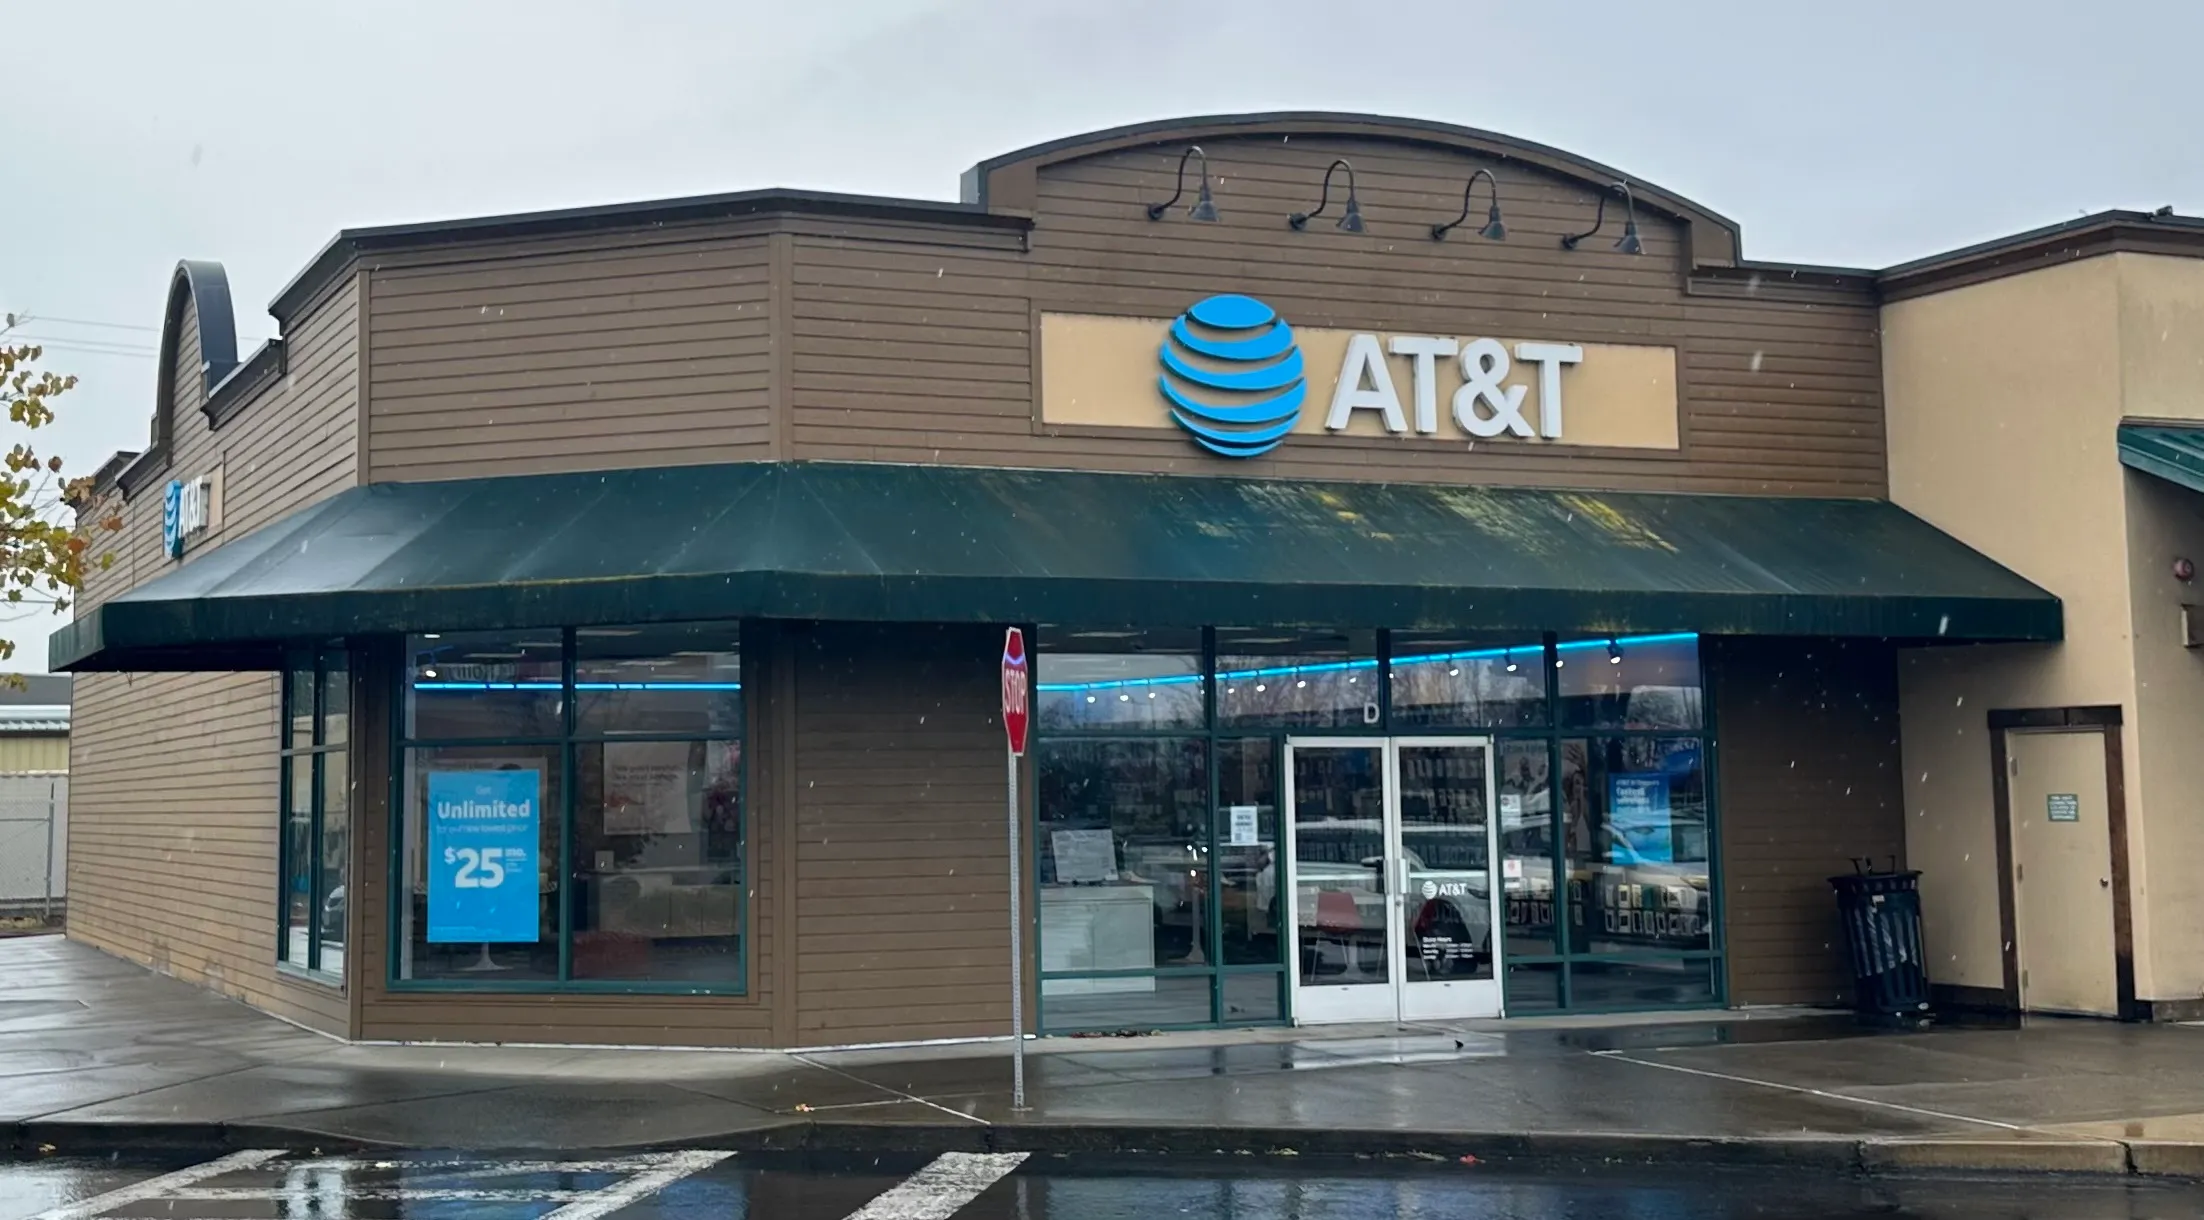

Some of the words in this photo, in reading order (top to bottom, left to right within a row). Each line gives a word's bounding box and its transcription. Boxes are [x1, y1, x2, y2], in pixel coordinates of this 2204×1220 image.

[1324, 333, 1583, 440] AT&T
[178, 475, 207, 538] AT&T
[1004, 668, 1026, 715] STOP
[1364, 702, 1380, 723] D
[437, 799, 531, 819] Unlimited
[444, 845, 505, 889] $25
[1438, 883, 1468, 896] AT&T
